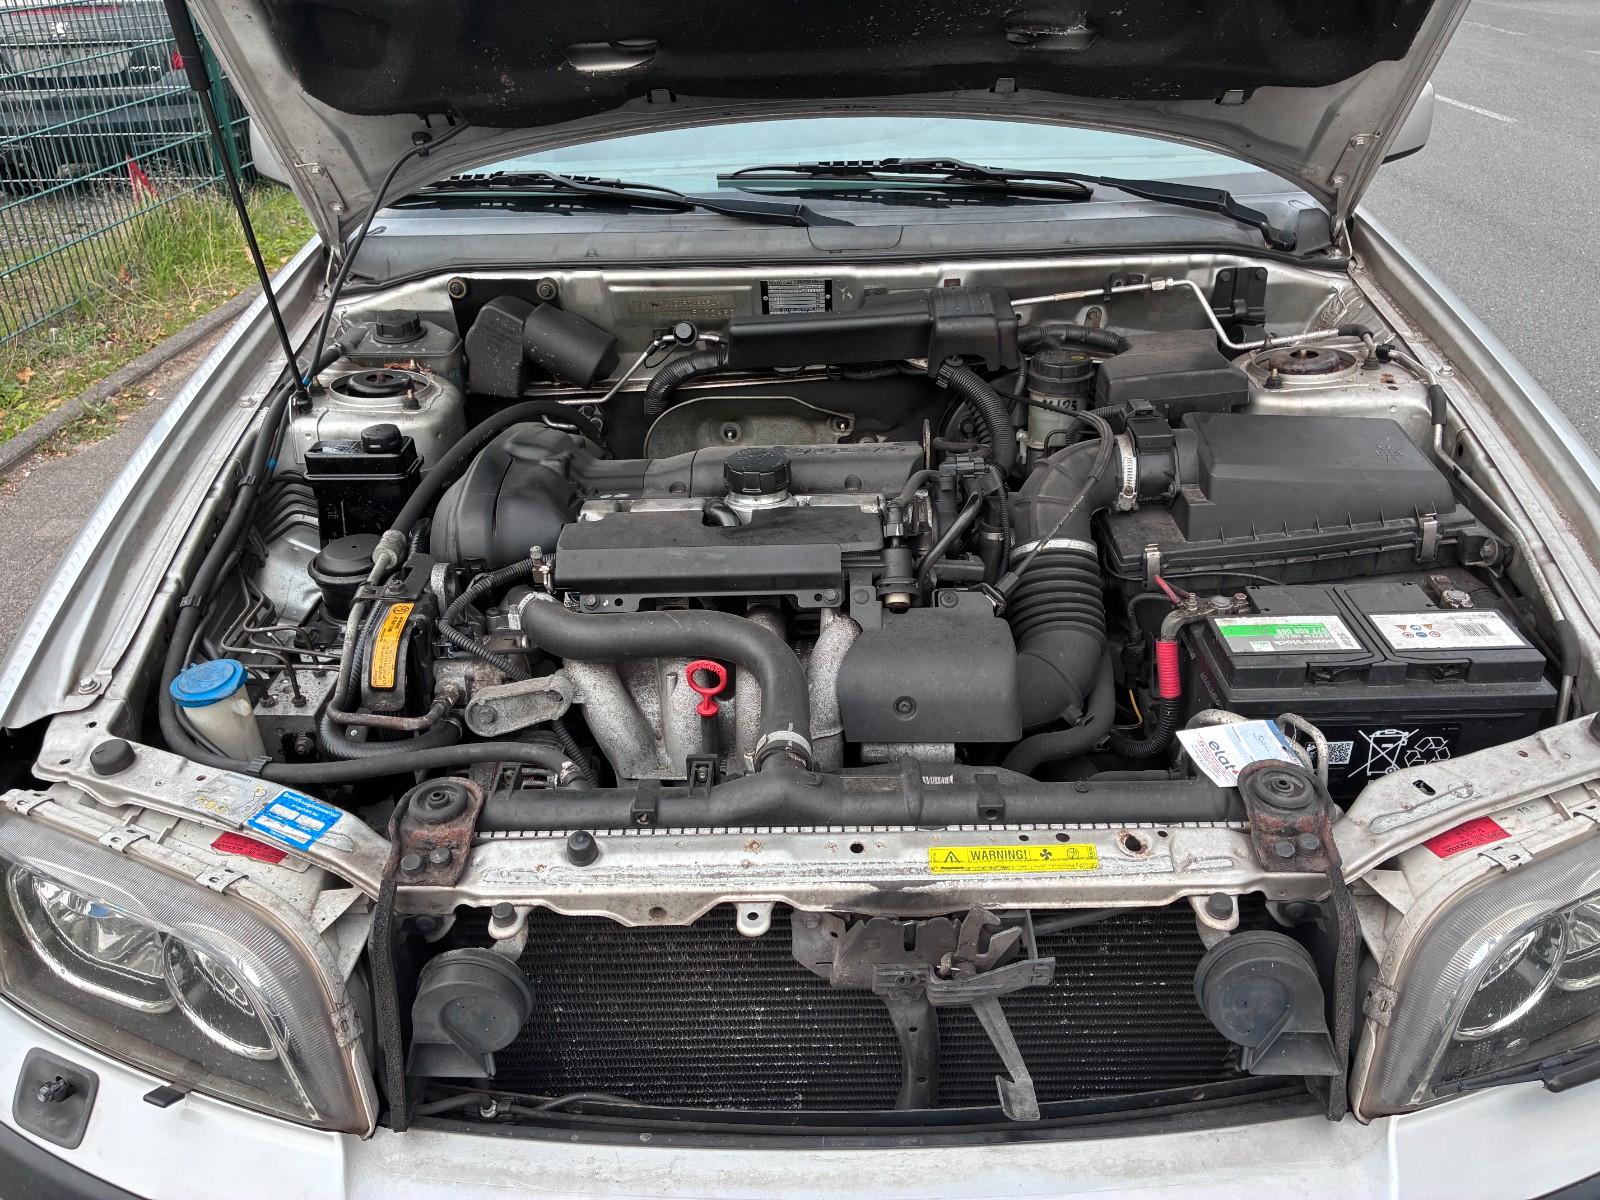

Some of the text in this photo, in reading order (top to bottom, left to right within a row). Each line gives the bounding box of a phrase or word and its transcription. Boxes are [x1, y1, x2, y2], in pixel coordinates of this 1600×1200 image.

[1208, 740, 1236, 771] elat
[1445, 841, 1472, 853] VOLVO
[970, 849, 1028, 861] WARNING!
